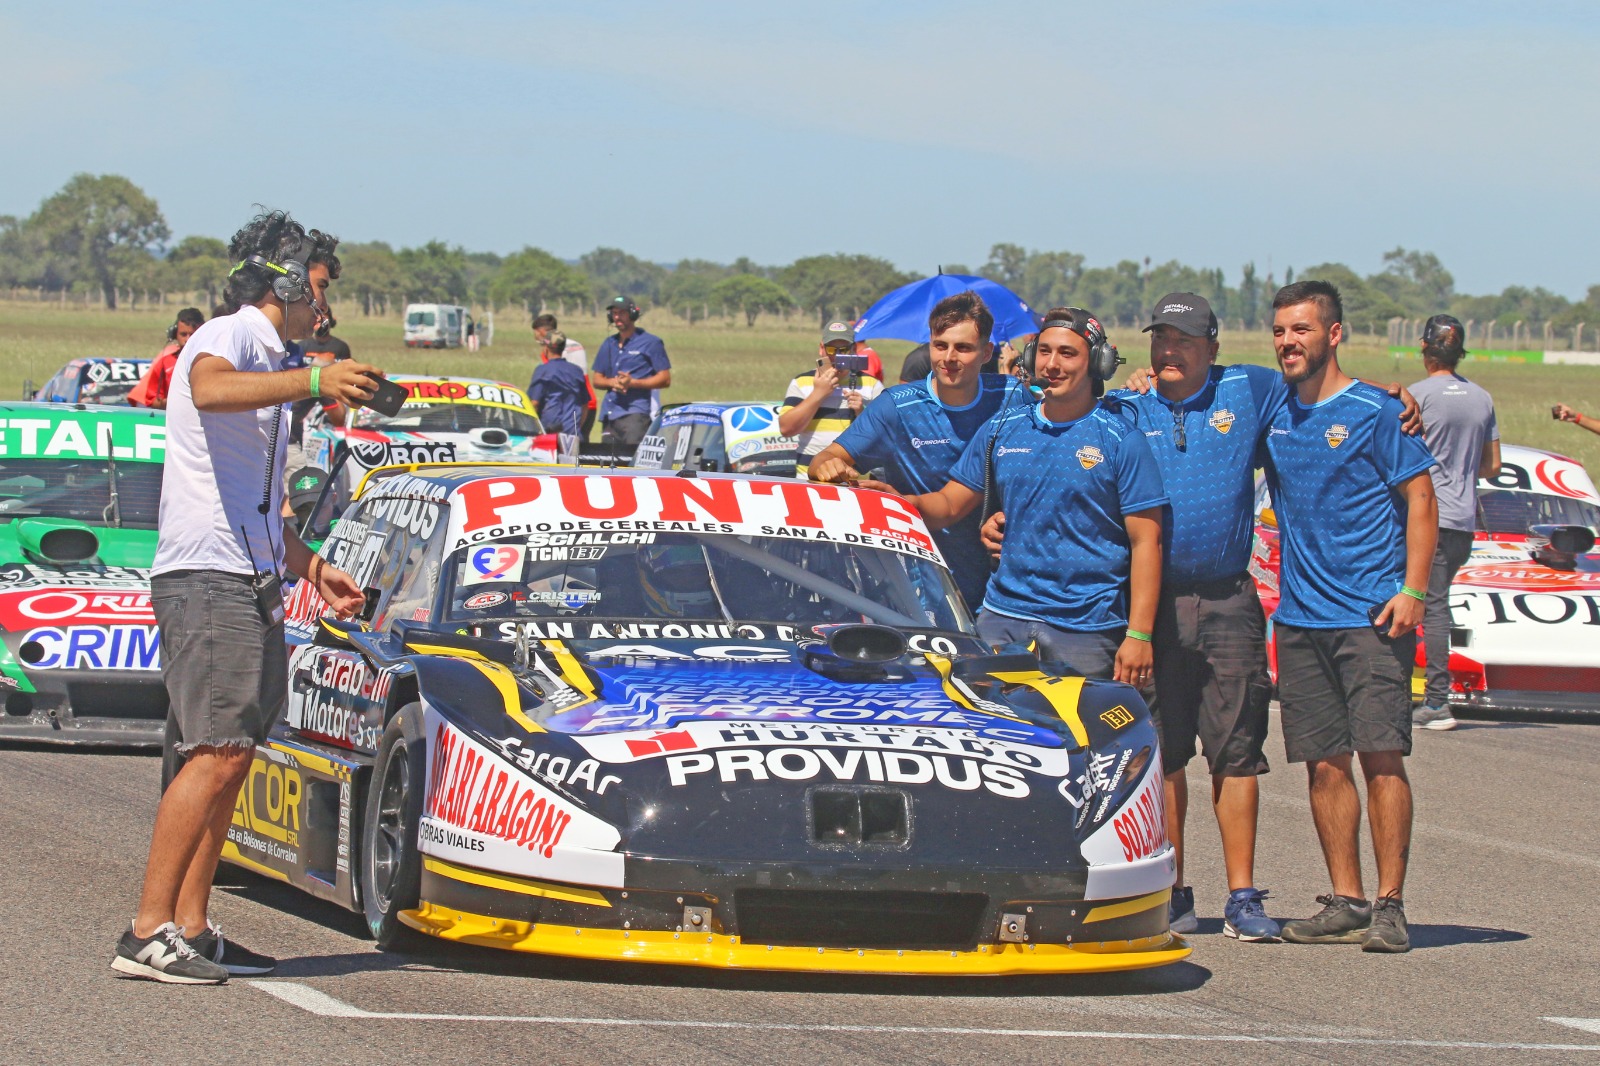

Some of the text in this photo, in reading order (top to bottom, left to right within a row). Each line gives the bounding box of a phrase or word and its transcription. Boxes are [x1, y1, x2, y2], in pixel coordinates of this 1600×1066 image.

[390, 447, 457, 465] BOG
[457, 476, 934, 552] PUNTE
[455, 521, 550, 549] ACOPIO
[560, 521, 582, 531] DE
[599, 520, 734, 533] CEREALES
[761, 525, 808, 540] SAN
[845, 533, 875, 547] DE
[881, 537, 941, 564] GILES
[526, 533, 656, 547] SCIALCHI
[530, 546, 607, 561] TCM 137
[529, 592, 601, 601] CRISTEM
[499, 622, 574, 639] SAN
[589, 623, 766, 641] ANTONIO
[303, 687, 378, 751] Motores SA
[1100, 705, 1135, 729] 137
[719, 729, 1042, 768] HURTADO
[728, 722, 1008, 748] METALURGICA
[490, 737, 623, 795] CargAr
[666, 748, 1031, 798] PROVIDUS
[469, 763, 571, 859] ARAGONI
[236, 831, 243, 843] en
[242, 830, 267, 853] Bolsones
[267, 840, 273, 856] de
[273, 842, 298, 864] Corralon
[287, 830, 300, 848] SRL
[420, 822, 485, 853] OBRAS VIALES
